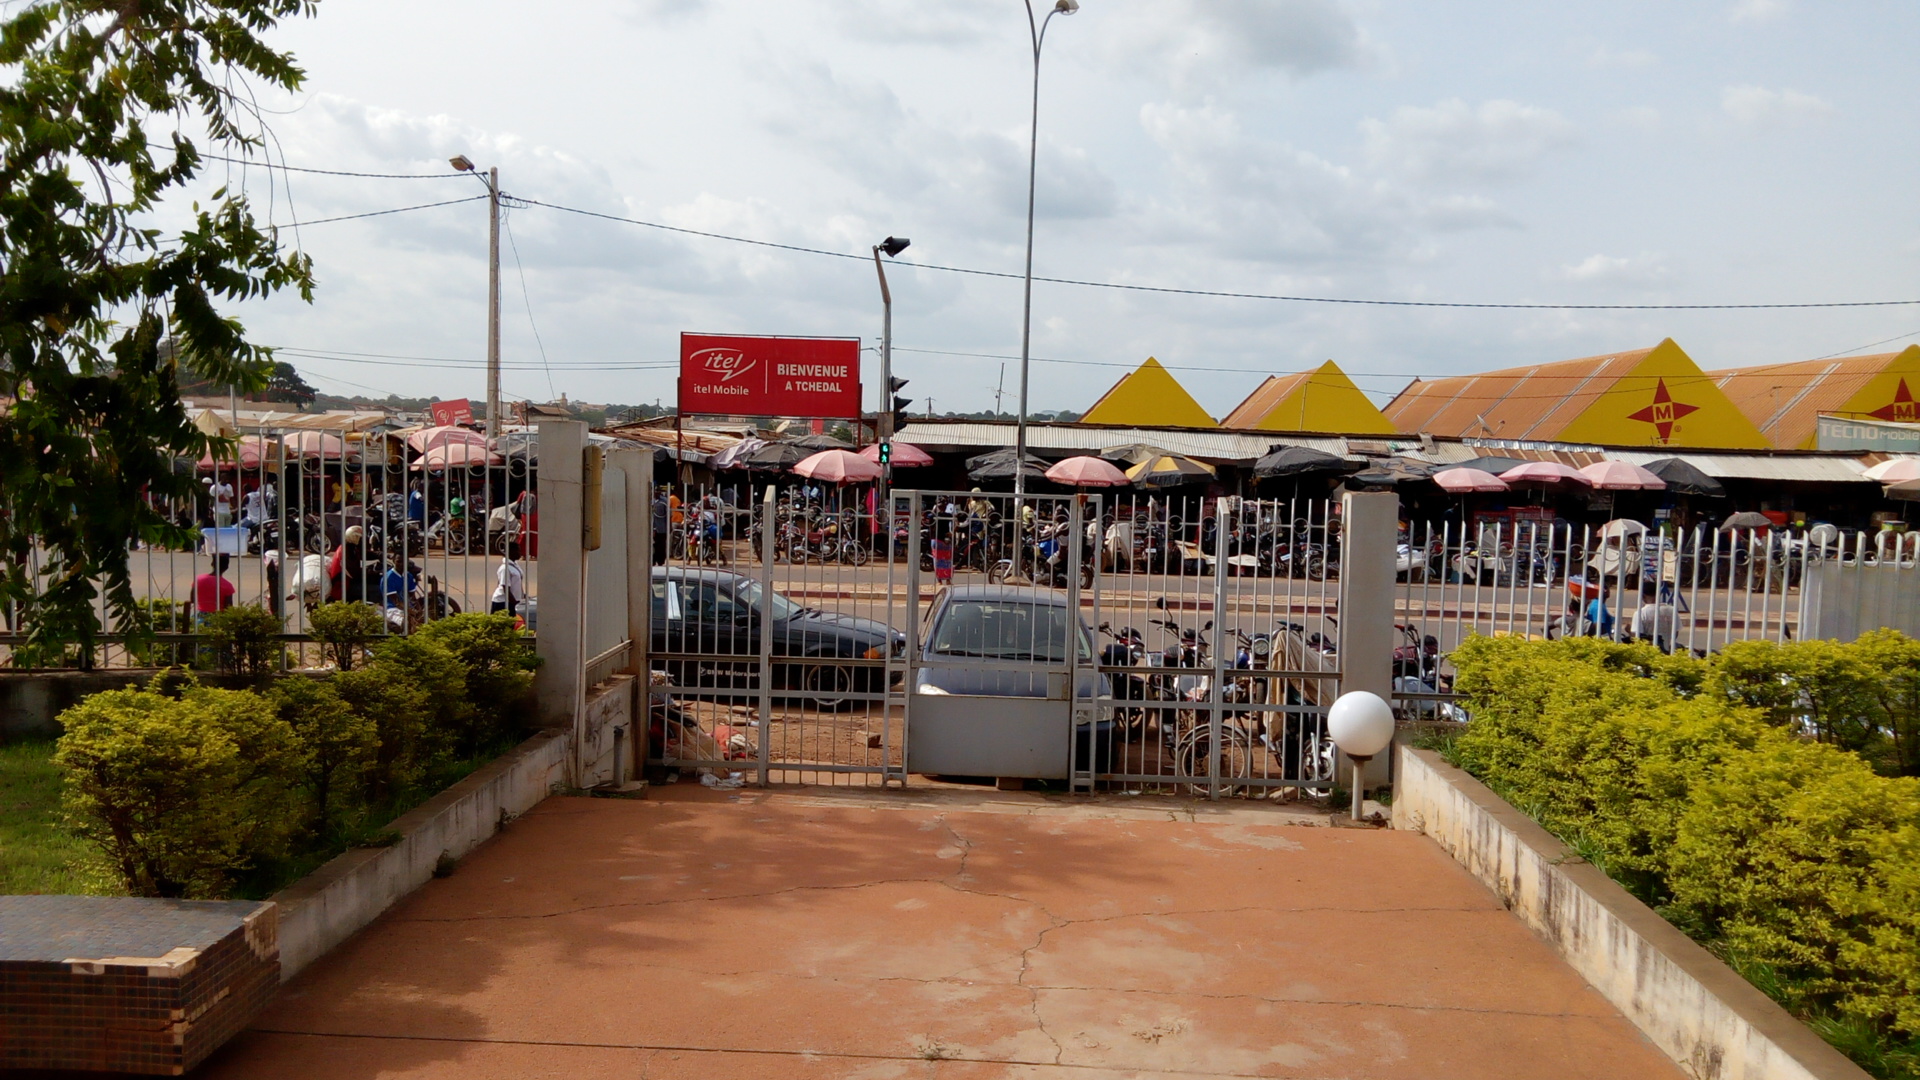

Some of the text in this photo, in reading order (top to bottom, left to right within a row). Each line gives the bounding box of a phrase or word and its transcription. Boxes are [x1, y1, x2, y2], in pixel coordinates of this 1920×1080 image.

[704, 352, 744, 369] itel
[693, 383, 750, 396] itel Mobile
[785, 380, 842, 393] A TCHEDAL
[1655, 404, 1672, 420] M
[1819, 423, 1879, 440] TECNO
